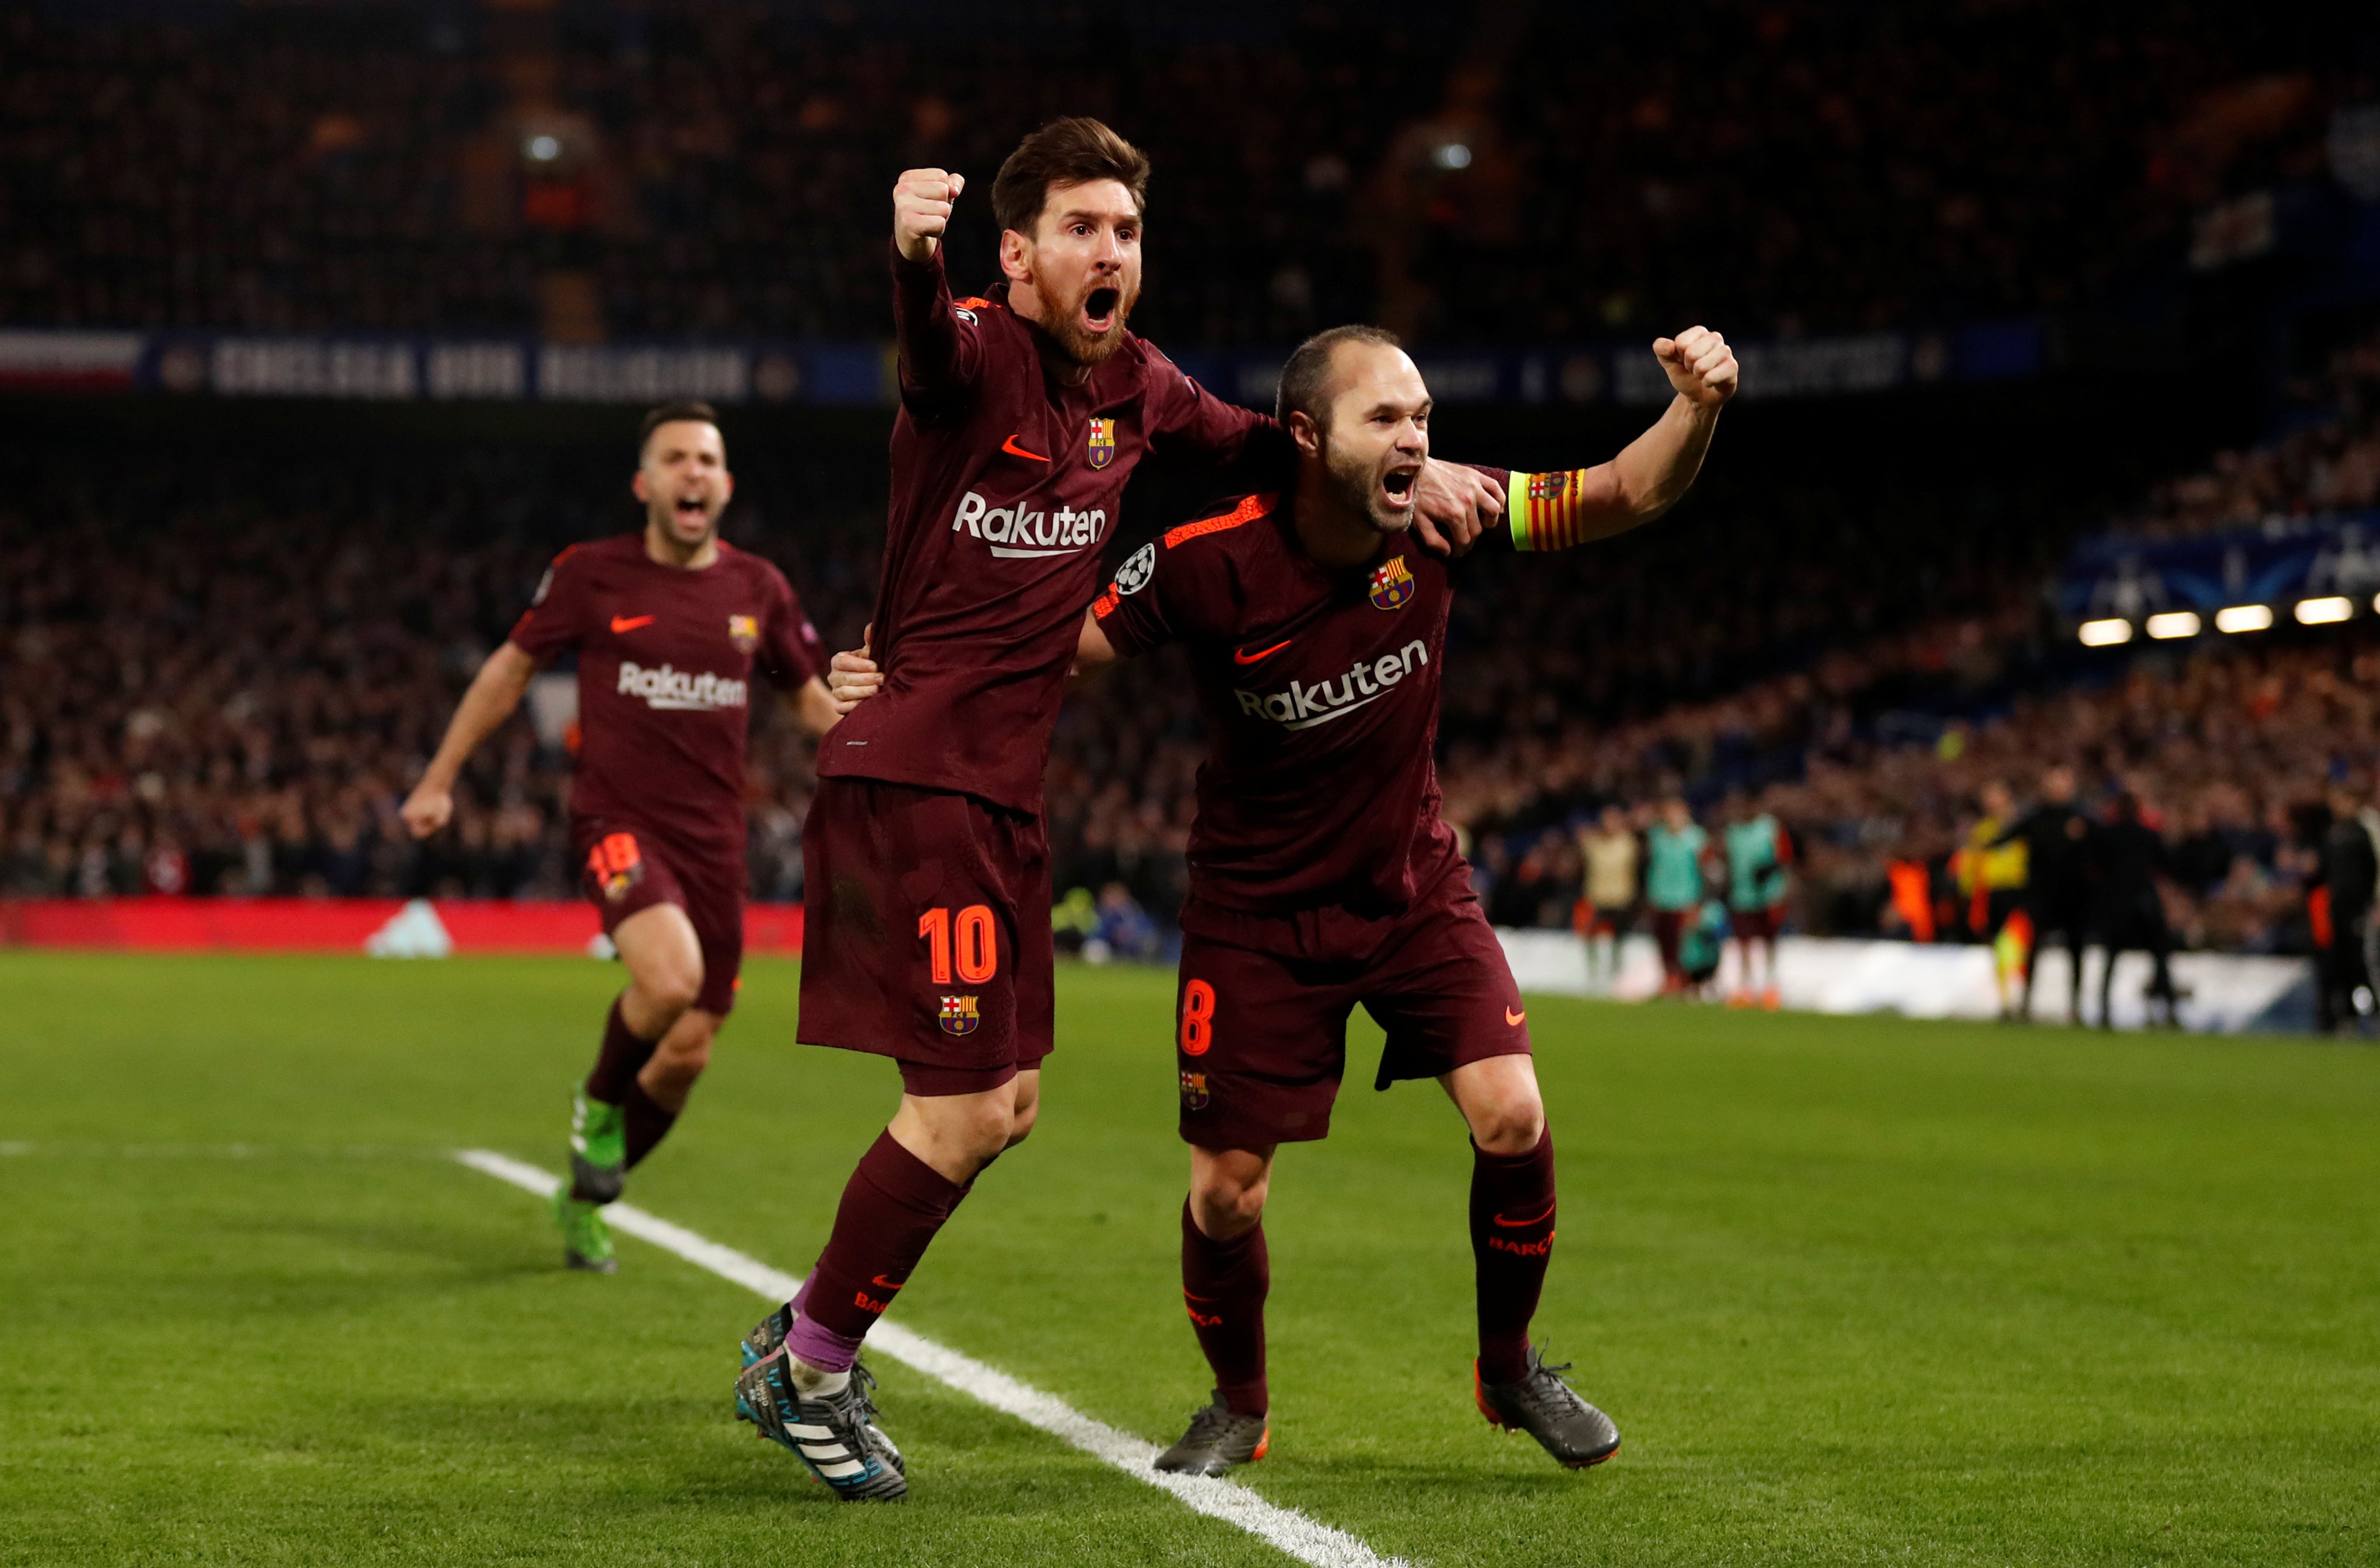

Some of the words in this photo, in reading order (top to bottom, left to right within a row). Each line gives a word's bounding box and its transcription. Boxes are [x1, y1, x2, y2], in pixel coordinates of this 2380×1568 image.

[952, 491, 1106, 546] Rakuten
[617, 661, 747, 708] Rakuten
[1233, 639, 1428, 722] Rakuten
[586, 832, 640, 888] 18
[919, 905, 997, 984] 10
[1181, 979, 1215, 1056] 8
